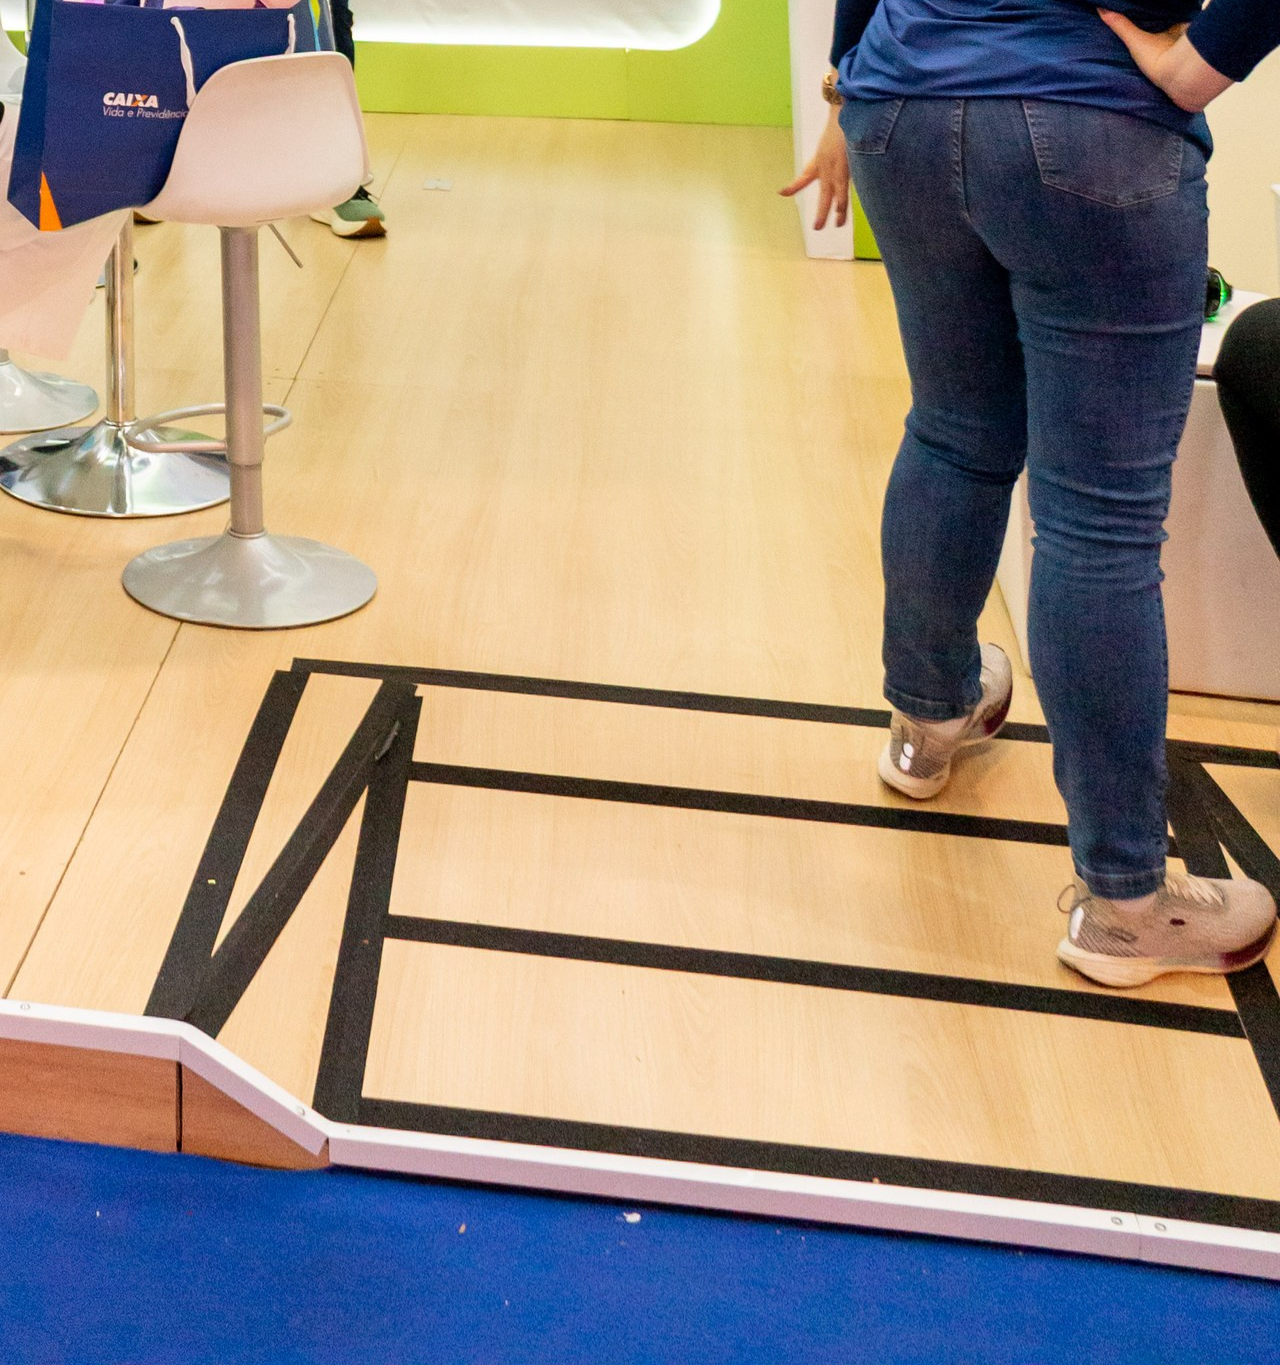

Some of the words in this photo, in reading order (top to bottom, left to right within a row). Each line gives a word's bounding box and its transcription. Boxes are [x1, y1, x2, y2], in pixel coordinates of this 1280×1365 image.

[103, 91, 159, 109] CAIXA
[103, 106, 125, 118] Vida
[127, 109, 134, 118] e
